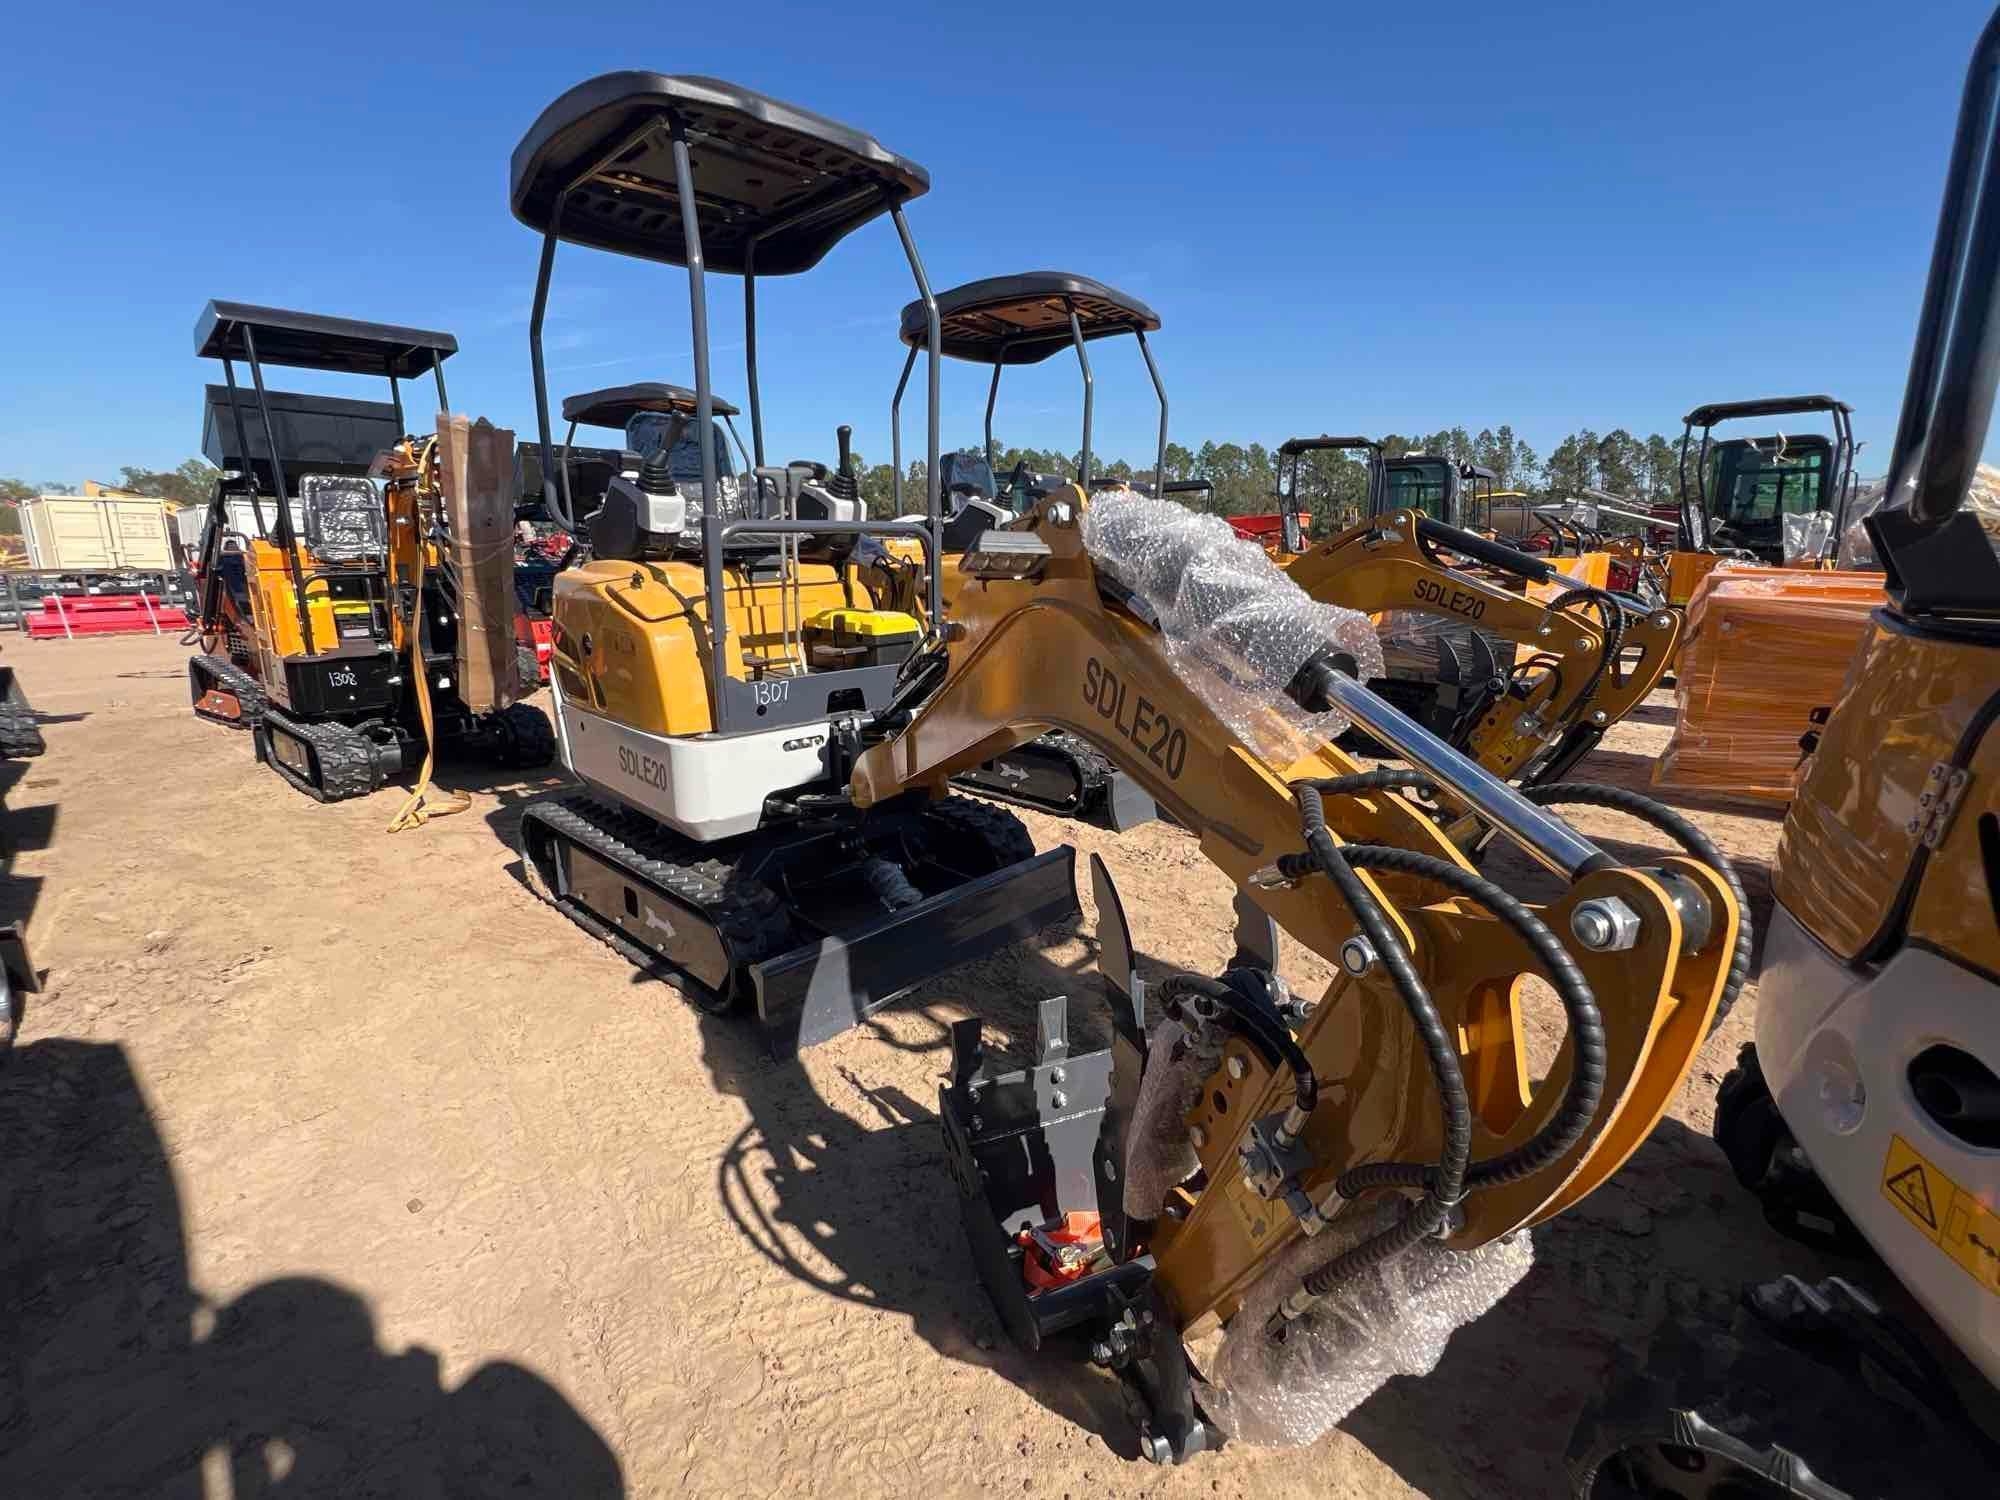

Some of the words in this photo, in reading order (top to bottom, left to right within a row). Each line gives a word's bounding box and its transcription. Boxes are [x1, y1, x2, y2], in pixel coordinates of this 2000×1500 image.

[1414, 578, 1486, 620] SDLE20
[328, 671, 358, 688] 1308
[754, 680, 790, 705] 1307
[1083, 657, 1187, 780] SDLE20
[618, 744, 667, 793] SDLE20
